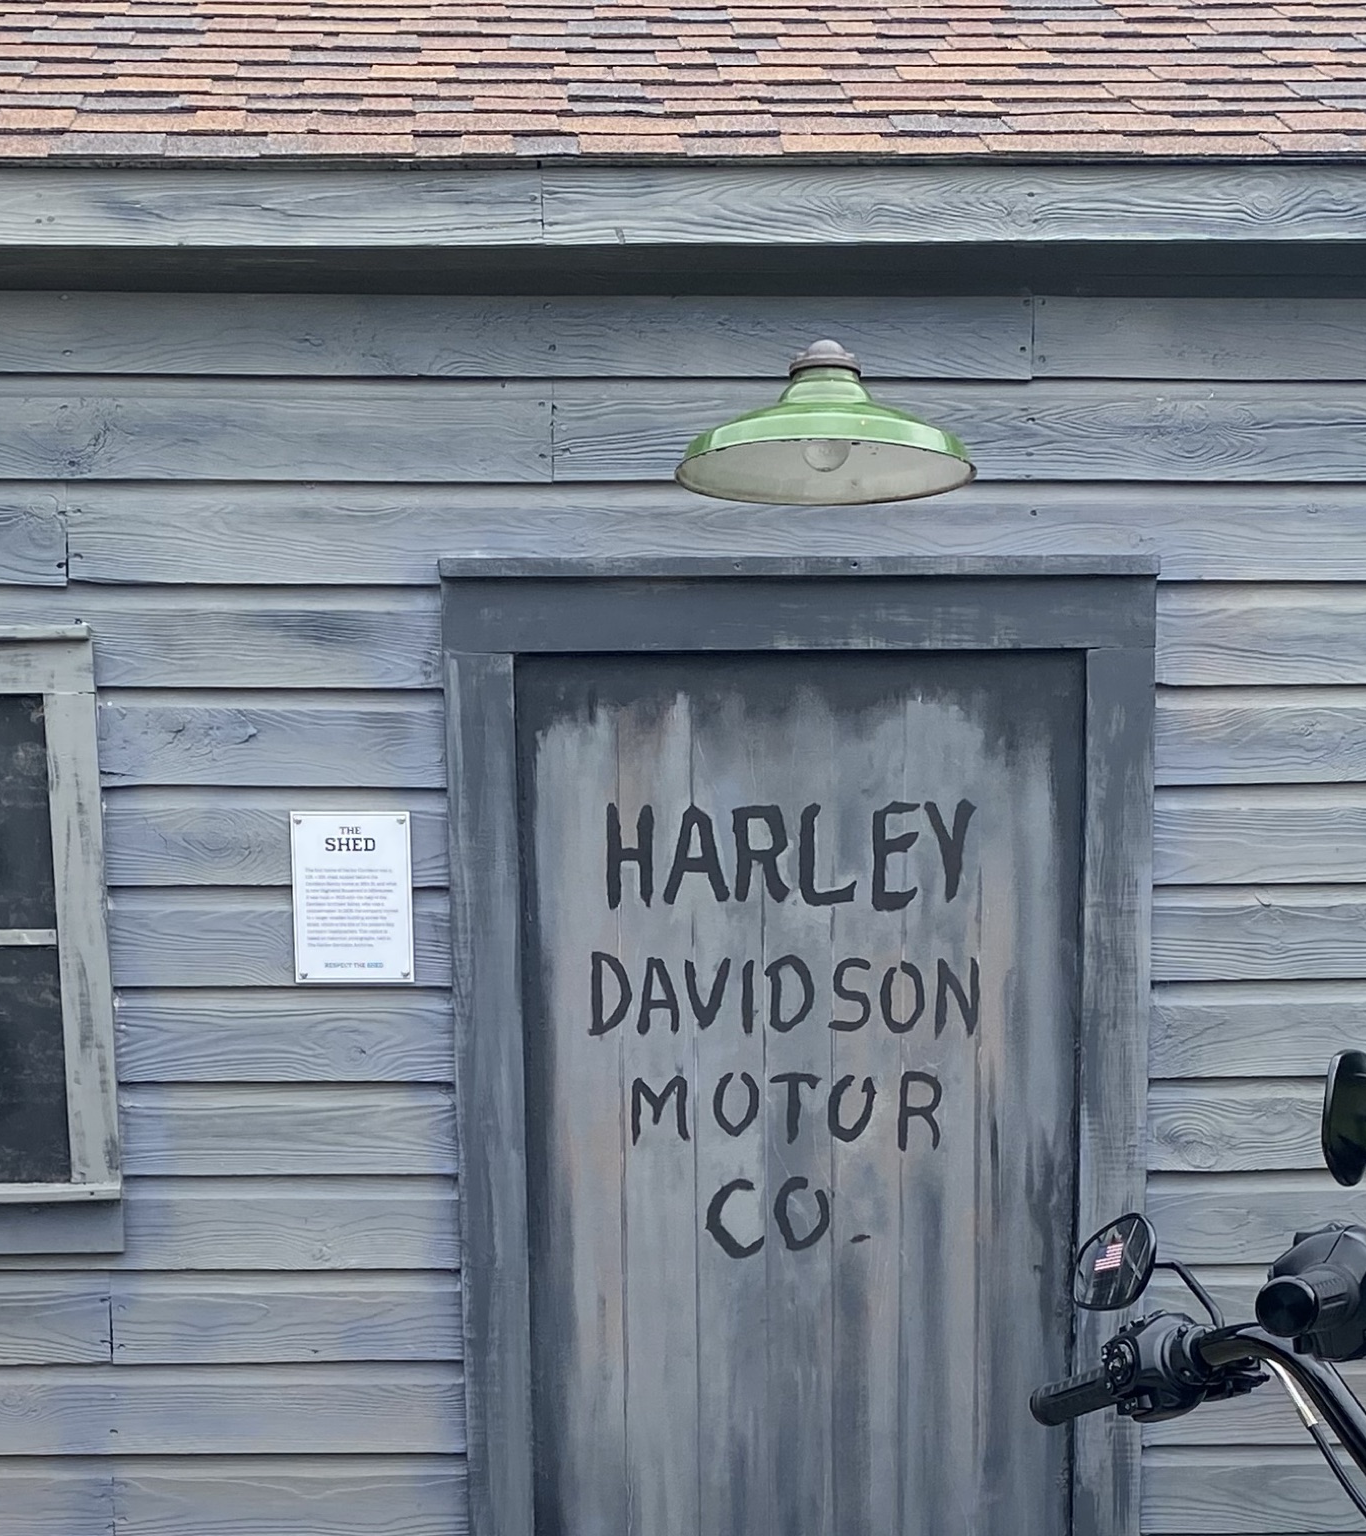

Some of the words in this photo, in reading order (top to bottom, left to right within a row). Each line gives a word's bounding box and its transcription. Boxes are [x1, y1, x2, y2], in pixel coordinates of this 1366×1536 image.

[325, 838, 376, 852] SHED
[339, 826, 362, 835] THE
[606, 799, 976, 911] HARLEY
[588, 951, 980, 1038] DAVIDSON
[632, 1071, 943, 1151] MOTOR
